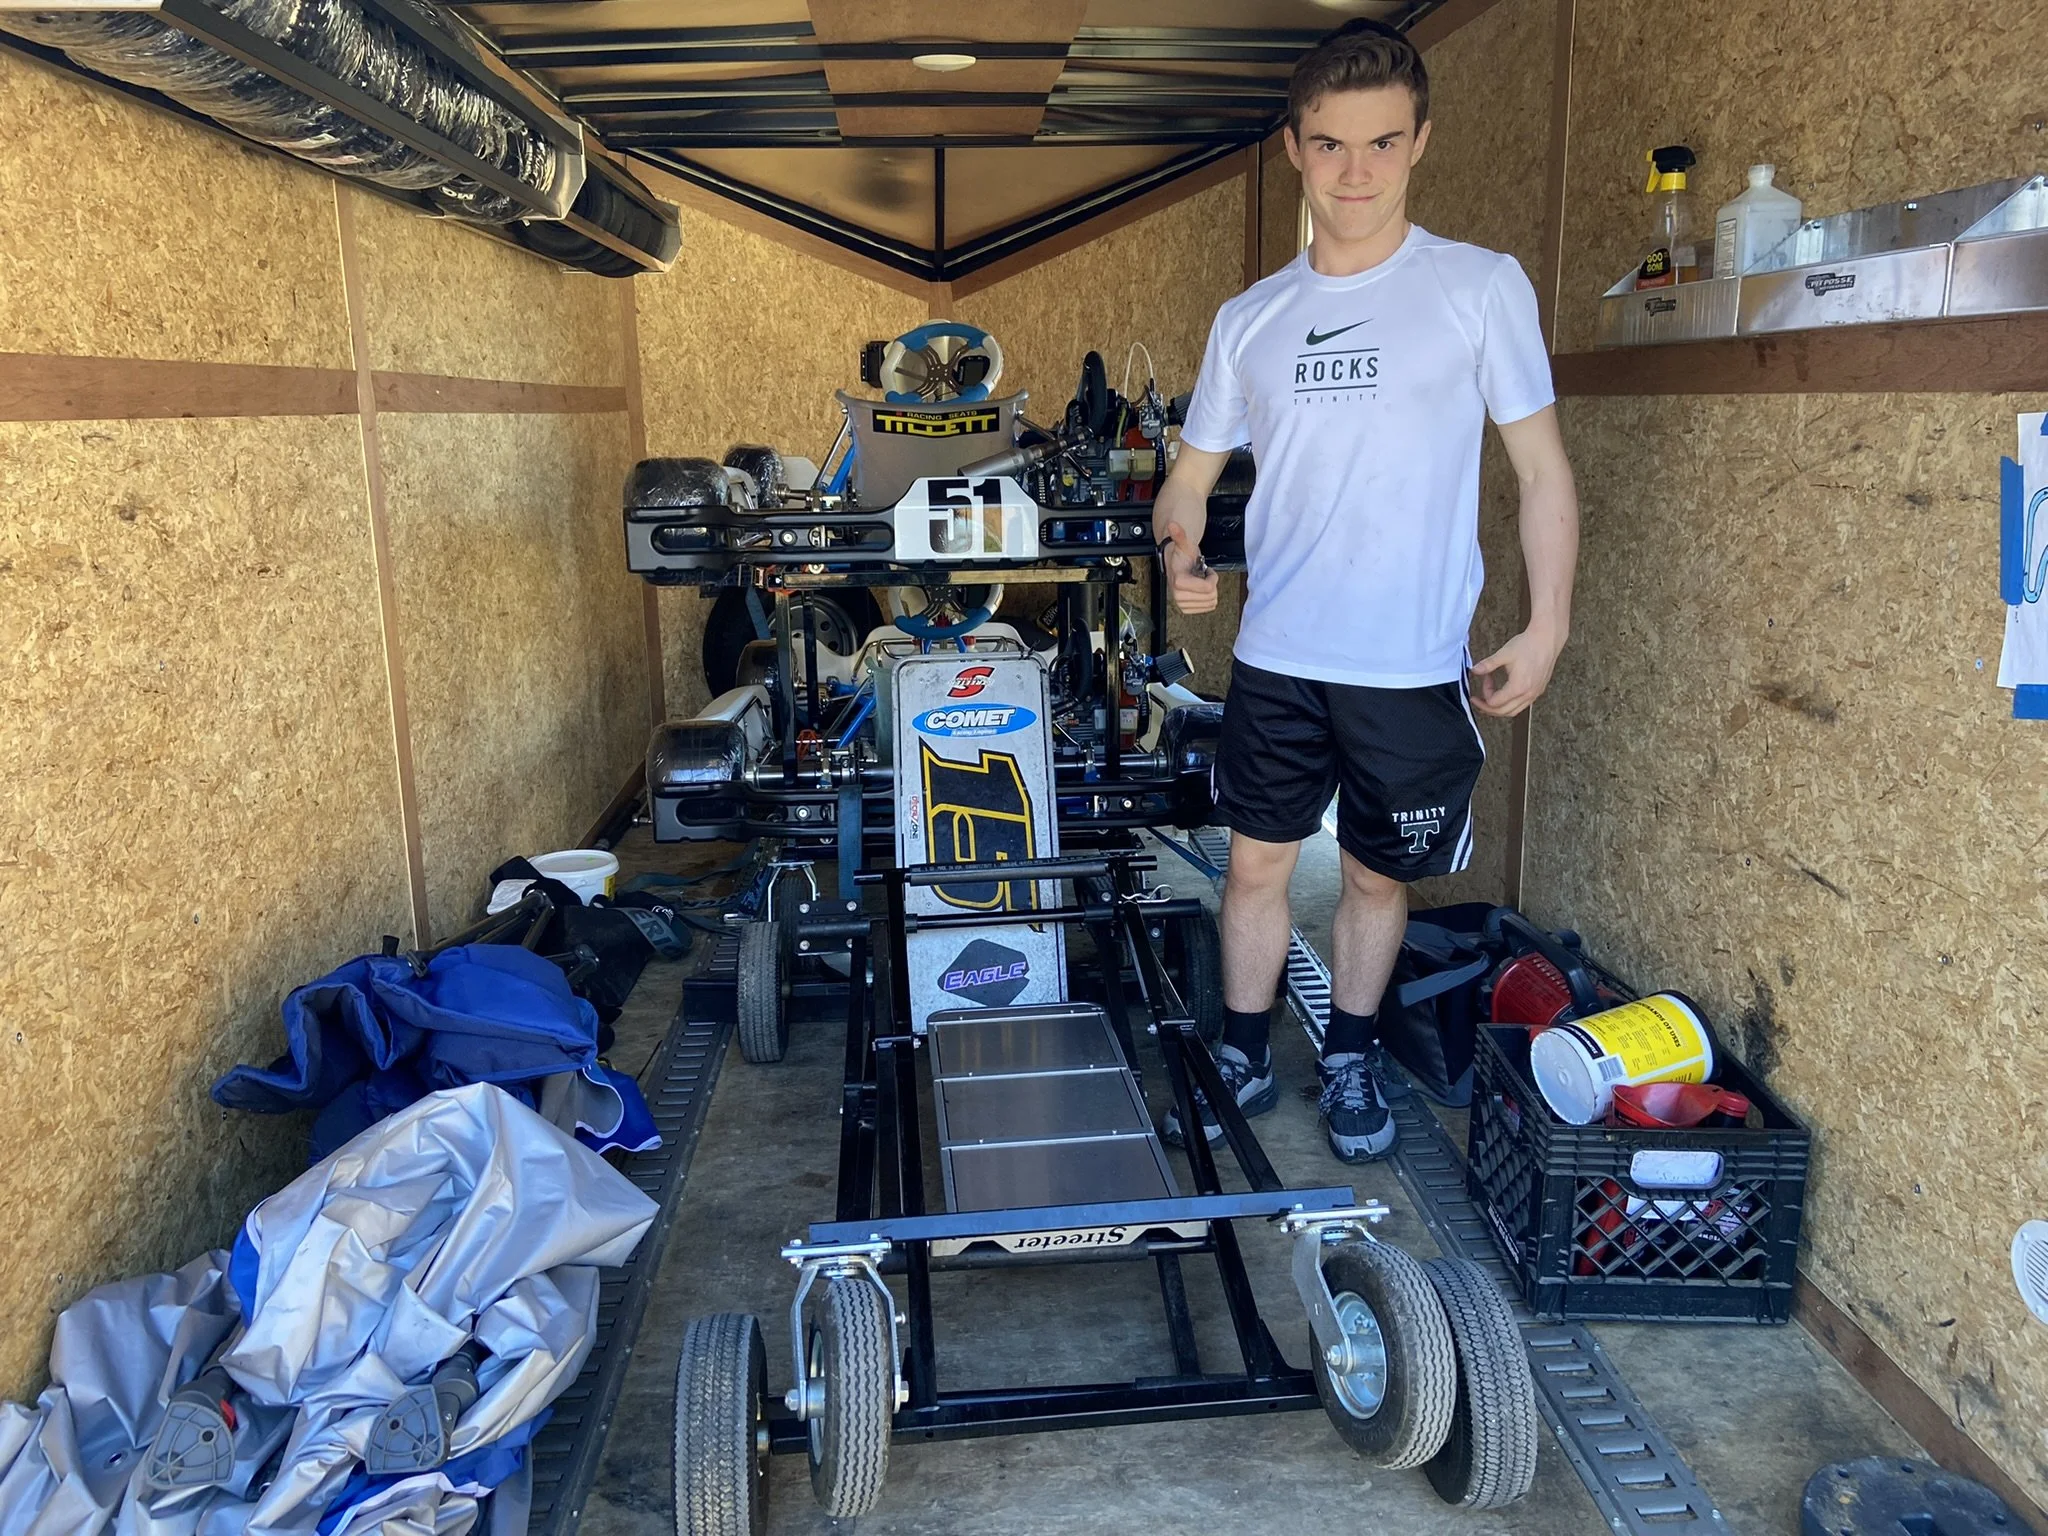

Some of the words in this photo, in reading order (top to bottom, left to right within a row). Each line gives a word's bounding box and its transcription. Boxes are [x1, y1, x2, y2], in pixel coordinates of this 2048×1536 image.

[1647, 252, 1663, 264] GOO
[1647, 262, 1663, 272] GONE
[1295, 357, 1378, 384] ROCKS
[1294, 394, 1377, 405] TRINITY
[876, 414, 997, 436] TILLETT
[907, 411, 942, 420] RACING
[948, 411, 978, 420] SEATS
[927, 479, 1003, 555] 51
[926, 708, 1016, 730] COMET
[1391, 806, 1445, 822] TRINITY
[1401, 820, 1440, 853] T
[943, 962, 1027, 991] EAGLE
[1663, 1021, 1672, 1031] OF
[1670, 1031, 1682, 1048] USES
[1013, 1226, 1128, 1249] Streeter
